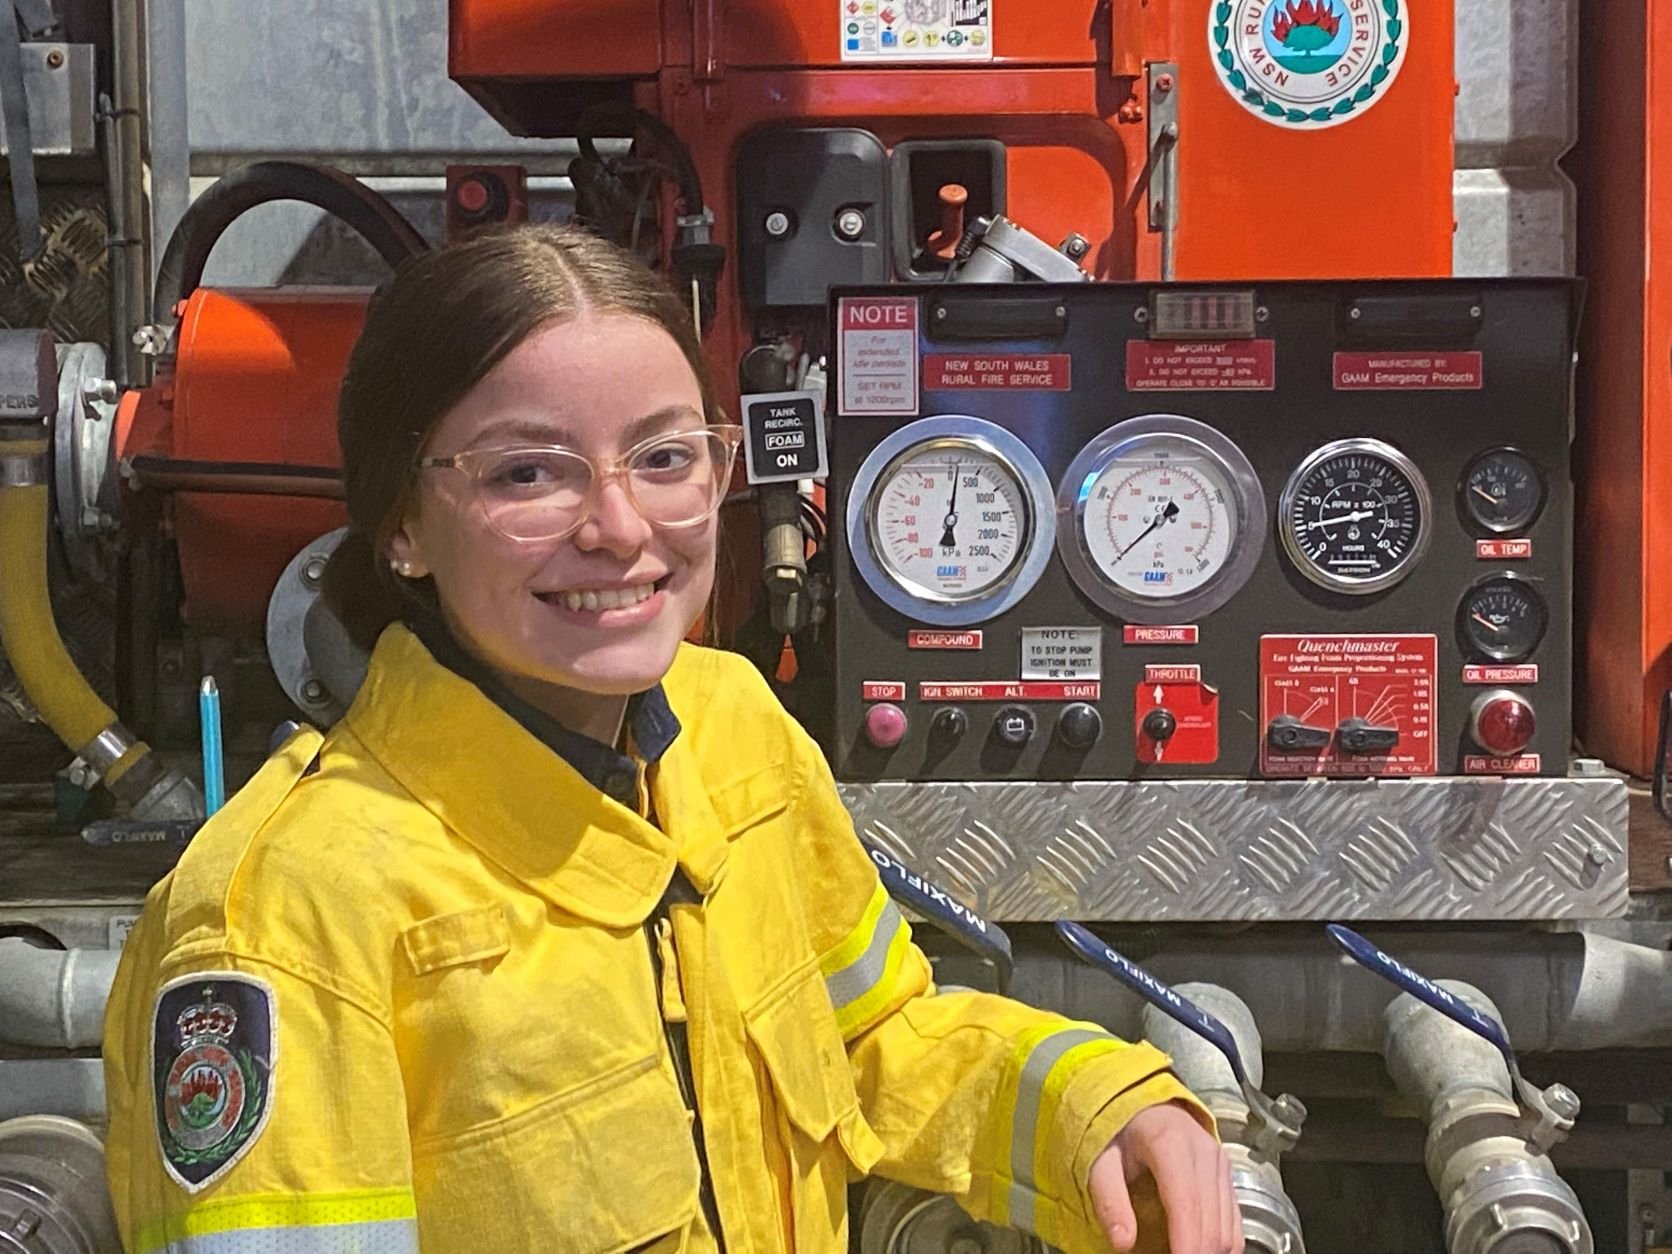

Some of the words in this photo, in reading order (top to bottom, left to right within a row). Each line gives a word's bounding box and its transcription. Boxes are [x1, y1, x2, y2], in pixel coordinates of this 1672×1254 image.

[1249, 47, 1289, 87] NSW
[1325, 0, 1369, 87] SERVICE
[850, 305, 908, 323] NOTE
[1174, 344, 1227, 353] IMPORTANT
[945, 360, 968, 371] NEW
[974, 360, 1009, 371] SOUTH
[1014, 360, 1049, 371] WALES
[1369, 359, 1431, 368] MANUFACTURED
[942, 374, 976, 385] RURAL
[981, 374, 1004, 385] FIRE
[1010, 374, 1052, 385] SERVICE
[1342, 373, 1370, 383] GAAM
[1375, 372, 1428, 384] Emergency
[1432, 371, 1474, 382] Products
[858, 382, 877, 390] SET
[879, 381, 902, 390] RPM
[770, 407, 796, 417] TANK
[764, 418, 804, 429] RECIRC.
[768, 434, 802, 447] FOAM
[776, 454, 798, 467] ON
[1347, 469, 1360, 478] 20
[918, 478, 934, 489] -20
[963, 477, 979, 488] 500
[1325, 479, 1334, 487] 15
[1370, 478, 1382, 487] 25
[976, 493, 995, 503] 1000
[1311, 496, 1321, 505] 10
[1385, 495, 1398, 504] 30
[982, 511, 1002, 522] 1500
[1387, 519, 1399, 528] 35
[978, 529, 999, 540] 2000
[1319, 542, 1327, 551] 0
[1377, 540, 1390, 548] 40
[1481, 545, 1496, 555] OIL
[1501, 544, 1527, 554] TEMP
[969, 546, 990, 557] 2500
[916, 634, 973, 645] COMPOUND
[1135, 629, 1185, 640] PRESSURE
[1031, 646, 1042, 655] TO
[1045, 646, 1066, 655] STOP
[1070, 646, 1092, 655] PUMP
[1297, 639, 1400, 653] Quenchmaster
[1030, 659, 1066, 667] IGNITION
[1069, 659, 1092, 667] MUST
[1149, 669, 1196, 679] THROTTLE
[1466, 670, 1481, 680] OIL
[1485, 669, 1534, 680] PRESSURE
[871, 686, 896, 697] STOP
[924, 687, 941, 697] IGN
[946, 686, 983, 697] SWITCH
[1005, 686, 1027, 697] ALT.
[1063, 686, 1096, 697] START
[1413, 730, 1428, 738] OFF
[1470, 759, 1486, 769] AIR
[1491, 759, 1535, 769] CLEANER
[871, 849, 987, 933] MAXIFLO
[1105, 948, 1182, 1007] MAXIFLO
[1376, 951, 1454, 1004] MAXIFLO
